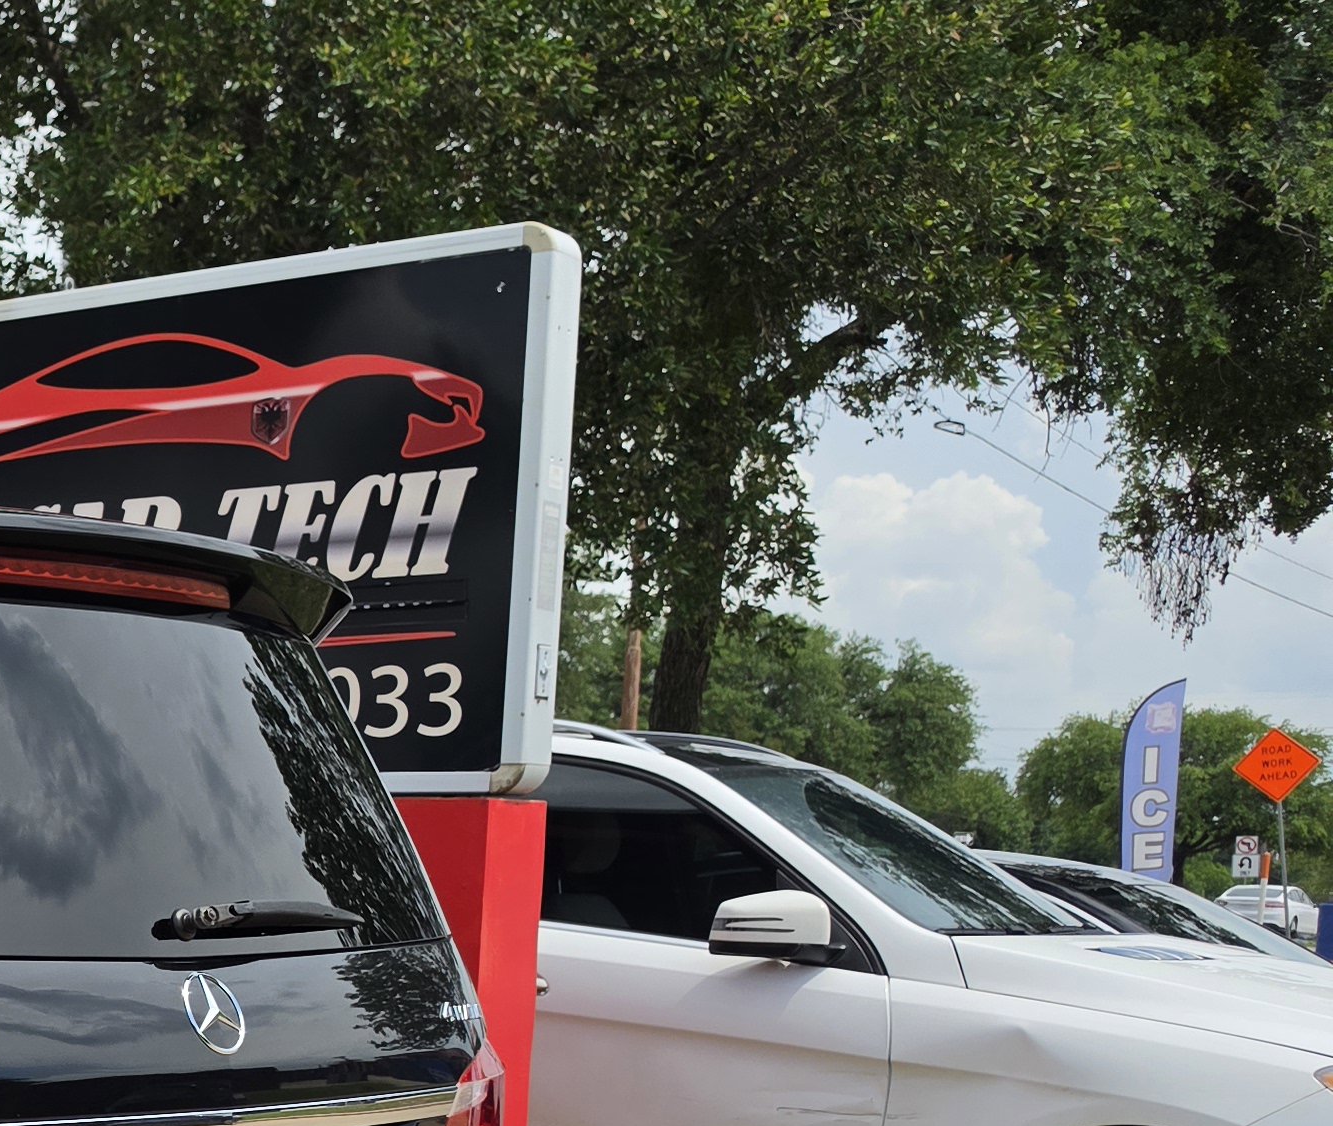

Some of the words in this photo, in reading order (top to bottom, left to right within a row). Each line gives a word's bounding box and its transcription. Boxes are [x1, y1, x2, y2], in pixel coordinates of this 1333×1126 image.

[217, 466, 478, 582] TECH
[1261, 744, 1292, 755] ROAD
[1262, 758, 1293, 768] WORK
[1259, 770, 1298, 781] AHEAD
[1130, 745, 1169, 872] ICE
